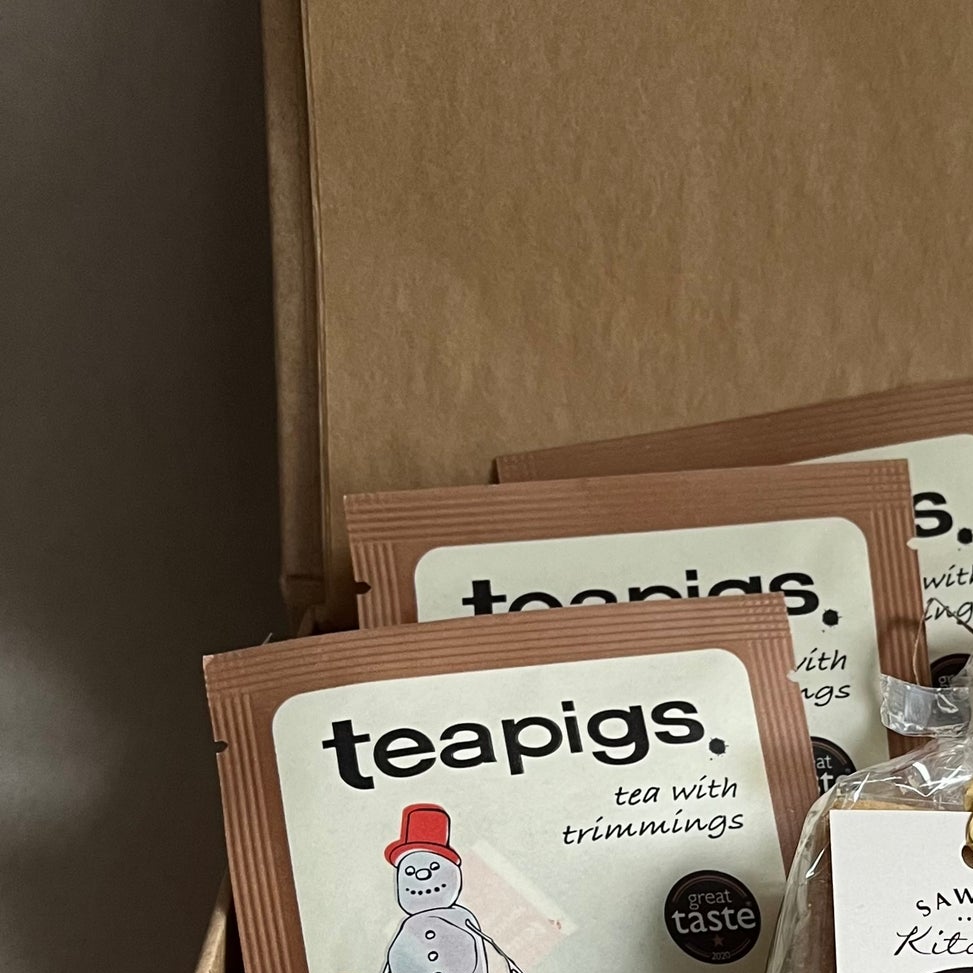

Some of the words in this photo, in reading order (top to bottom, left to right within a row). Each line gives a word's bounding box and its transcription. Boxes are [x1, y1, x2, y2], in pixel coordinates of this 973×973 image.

[322, 700, 728, 790] teapigs.
[614, 785, 660, 806] tea
[672, 776, 738, 802] with
[562, 809, 744, 845] trimmings
[688, 889, 732, 910] great
[671, 906, 757, 934] taste
[712, 951, 731, 960] 2020
